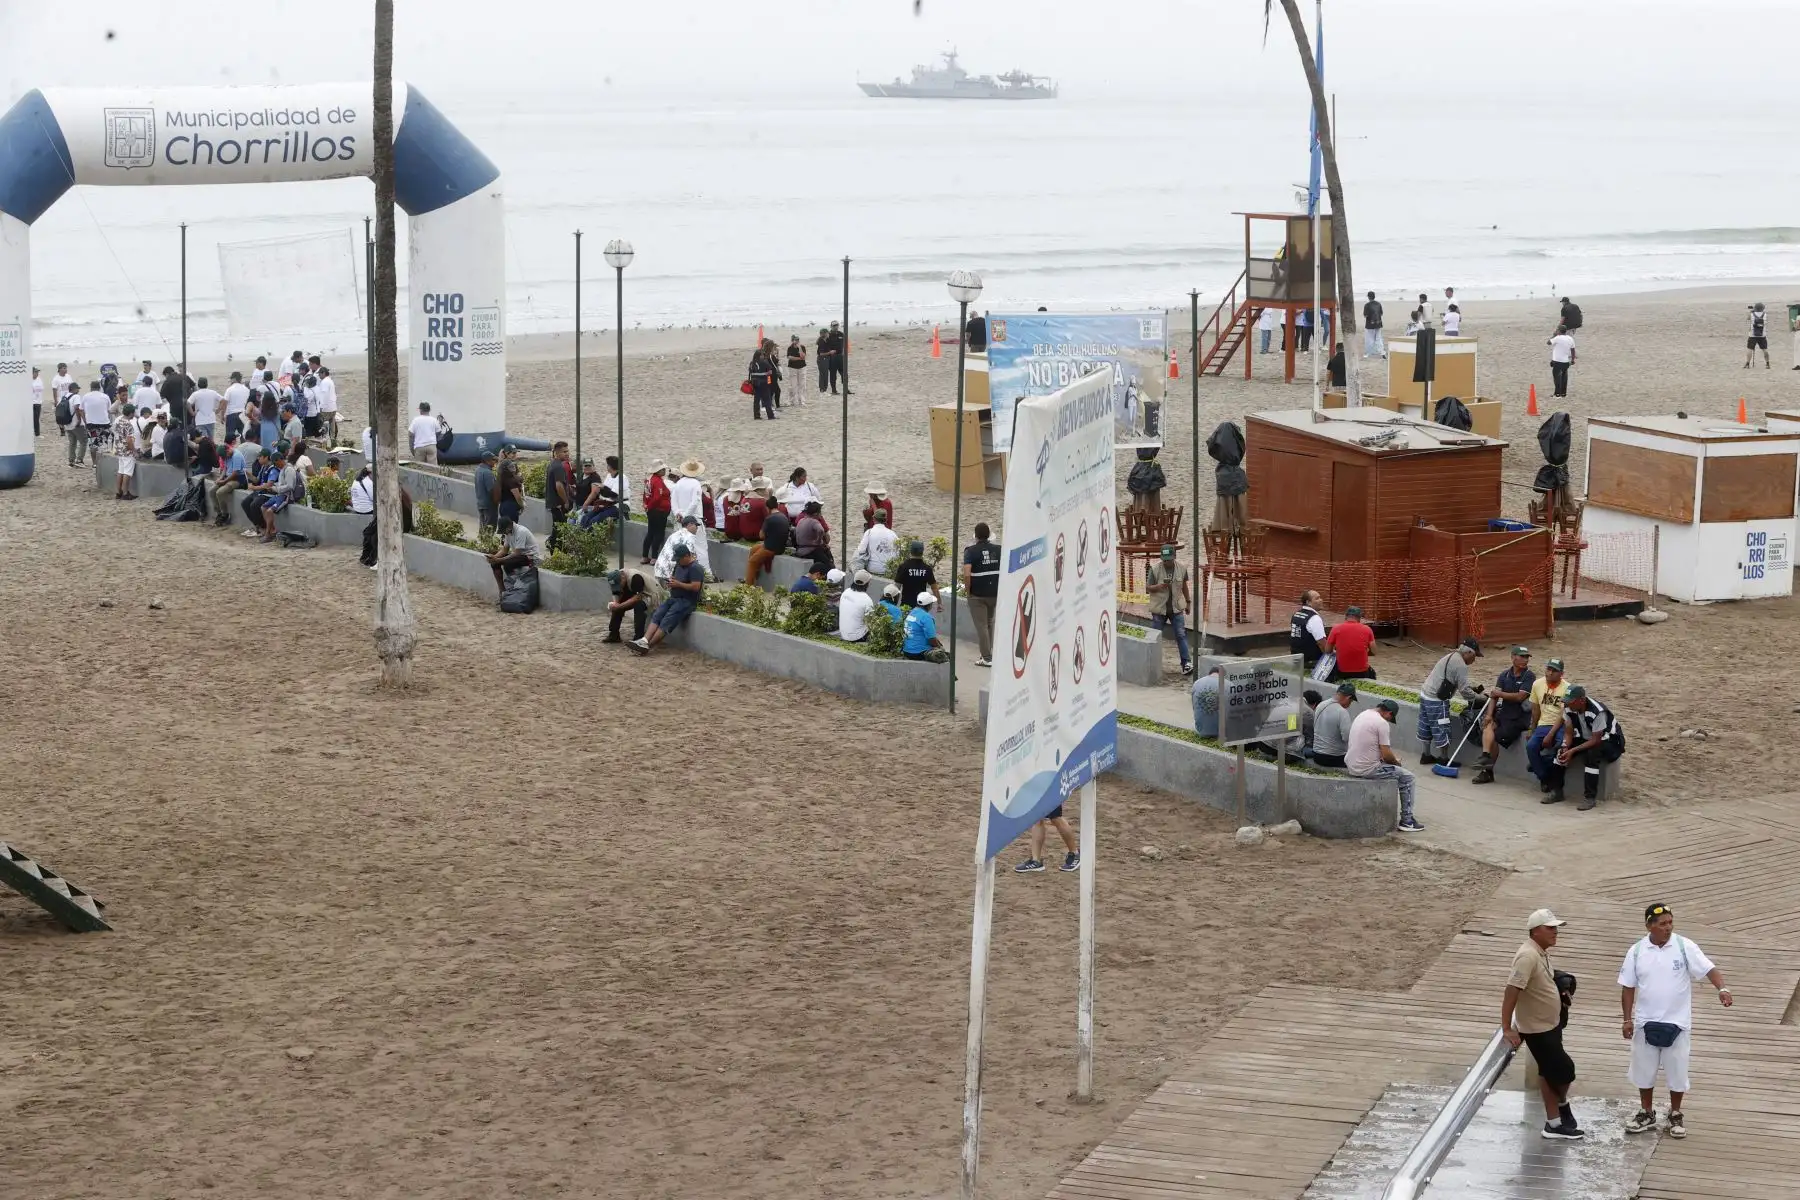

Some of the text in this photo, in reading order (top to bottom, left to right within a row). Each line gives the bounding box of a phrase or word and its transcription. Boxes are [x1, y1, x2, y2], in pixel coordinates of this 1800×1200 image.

[165, 106, 357, 131] Municipalidad de
[165, 130, 356, 166] Chorrillos
[423, 293, 464, 314] CHO
[471, 313, 497, 322] CIUDAD
[428, 317, 464, 338] RRI
[471, 322, 492, 331] PARA
[1032, 343, 1119, 357] DEJA SOLO HUELLAS
[1027, 360, 1053, 388] NO
[1746, 531, 1767, 547] CHO
[1749, 548, 1766, 563] RRI
[908, 568, 927, 577] STAFF
[1743, 564, 1765, 580] LLOS
[1238, 672, 1254, 680] esta
[1254, 670, 1273, 680] playa
[1229, 677, 1288, 694] no se habla
[1229, 691, 1289, 706] de cuerpos.
